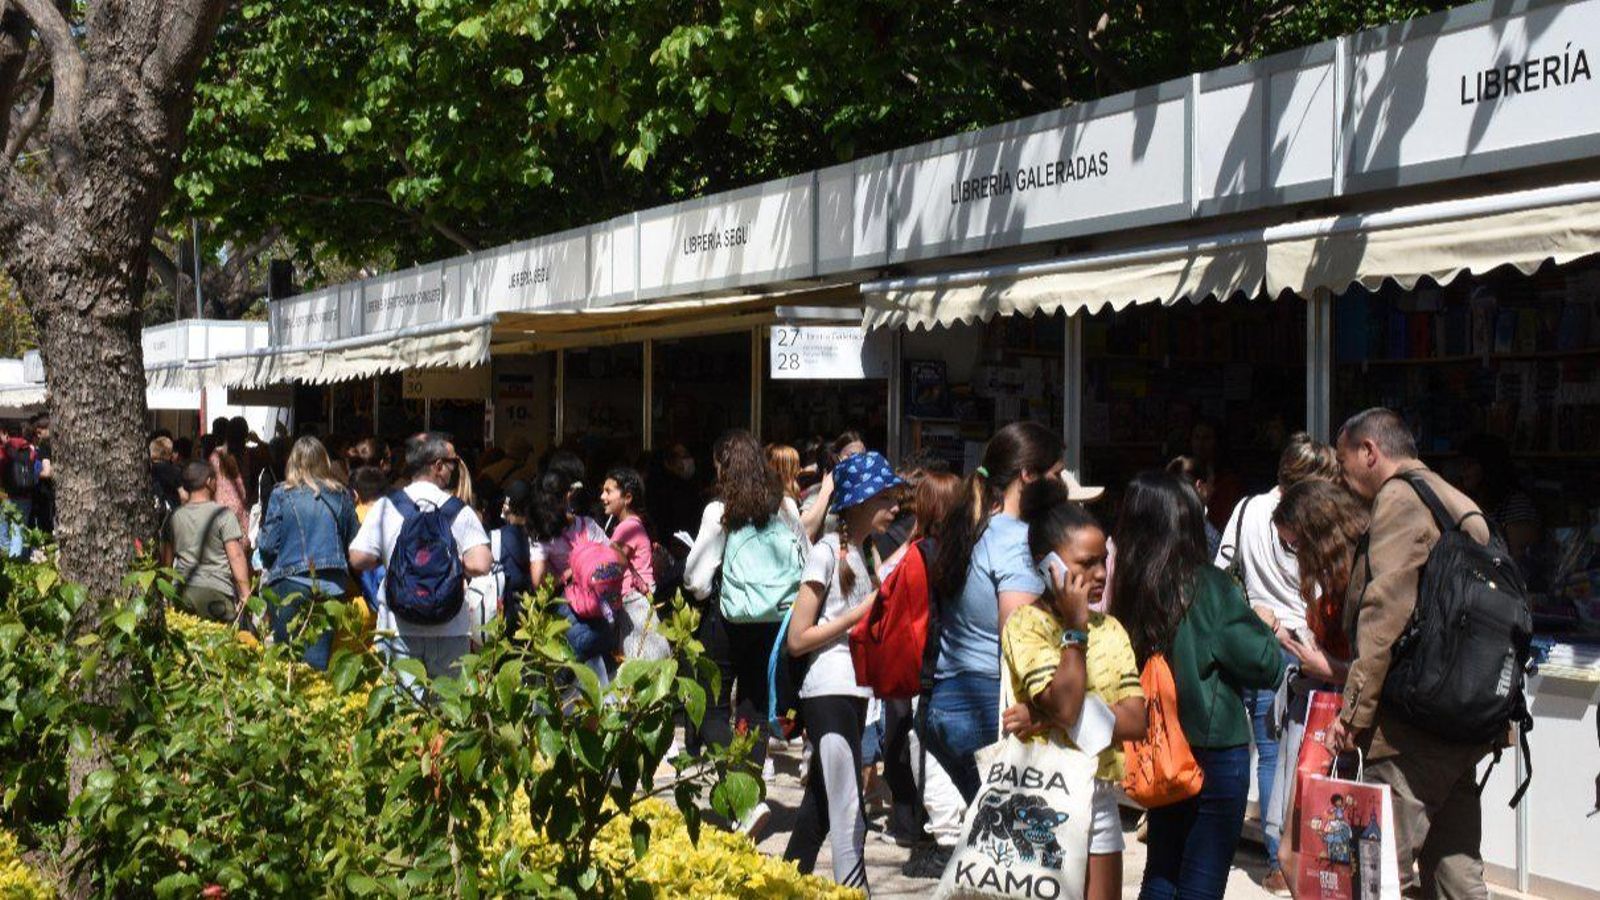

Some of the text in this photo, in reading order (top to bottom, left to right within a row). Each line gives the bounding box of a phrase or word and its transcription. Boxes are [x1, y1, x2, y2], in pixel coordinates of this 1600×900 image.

[1460, 42, 1592, 106] LIBRERÍA
[950, 151, 1109, 205] LIBRERÍA GALERADAS
[777, 328, 800, 347] 27
[777, 352, 800, 371] 28
[986, 762, 1070, 795] BABA
[954, 860, 1061, 900] KAMO
